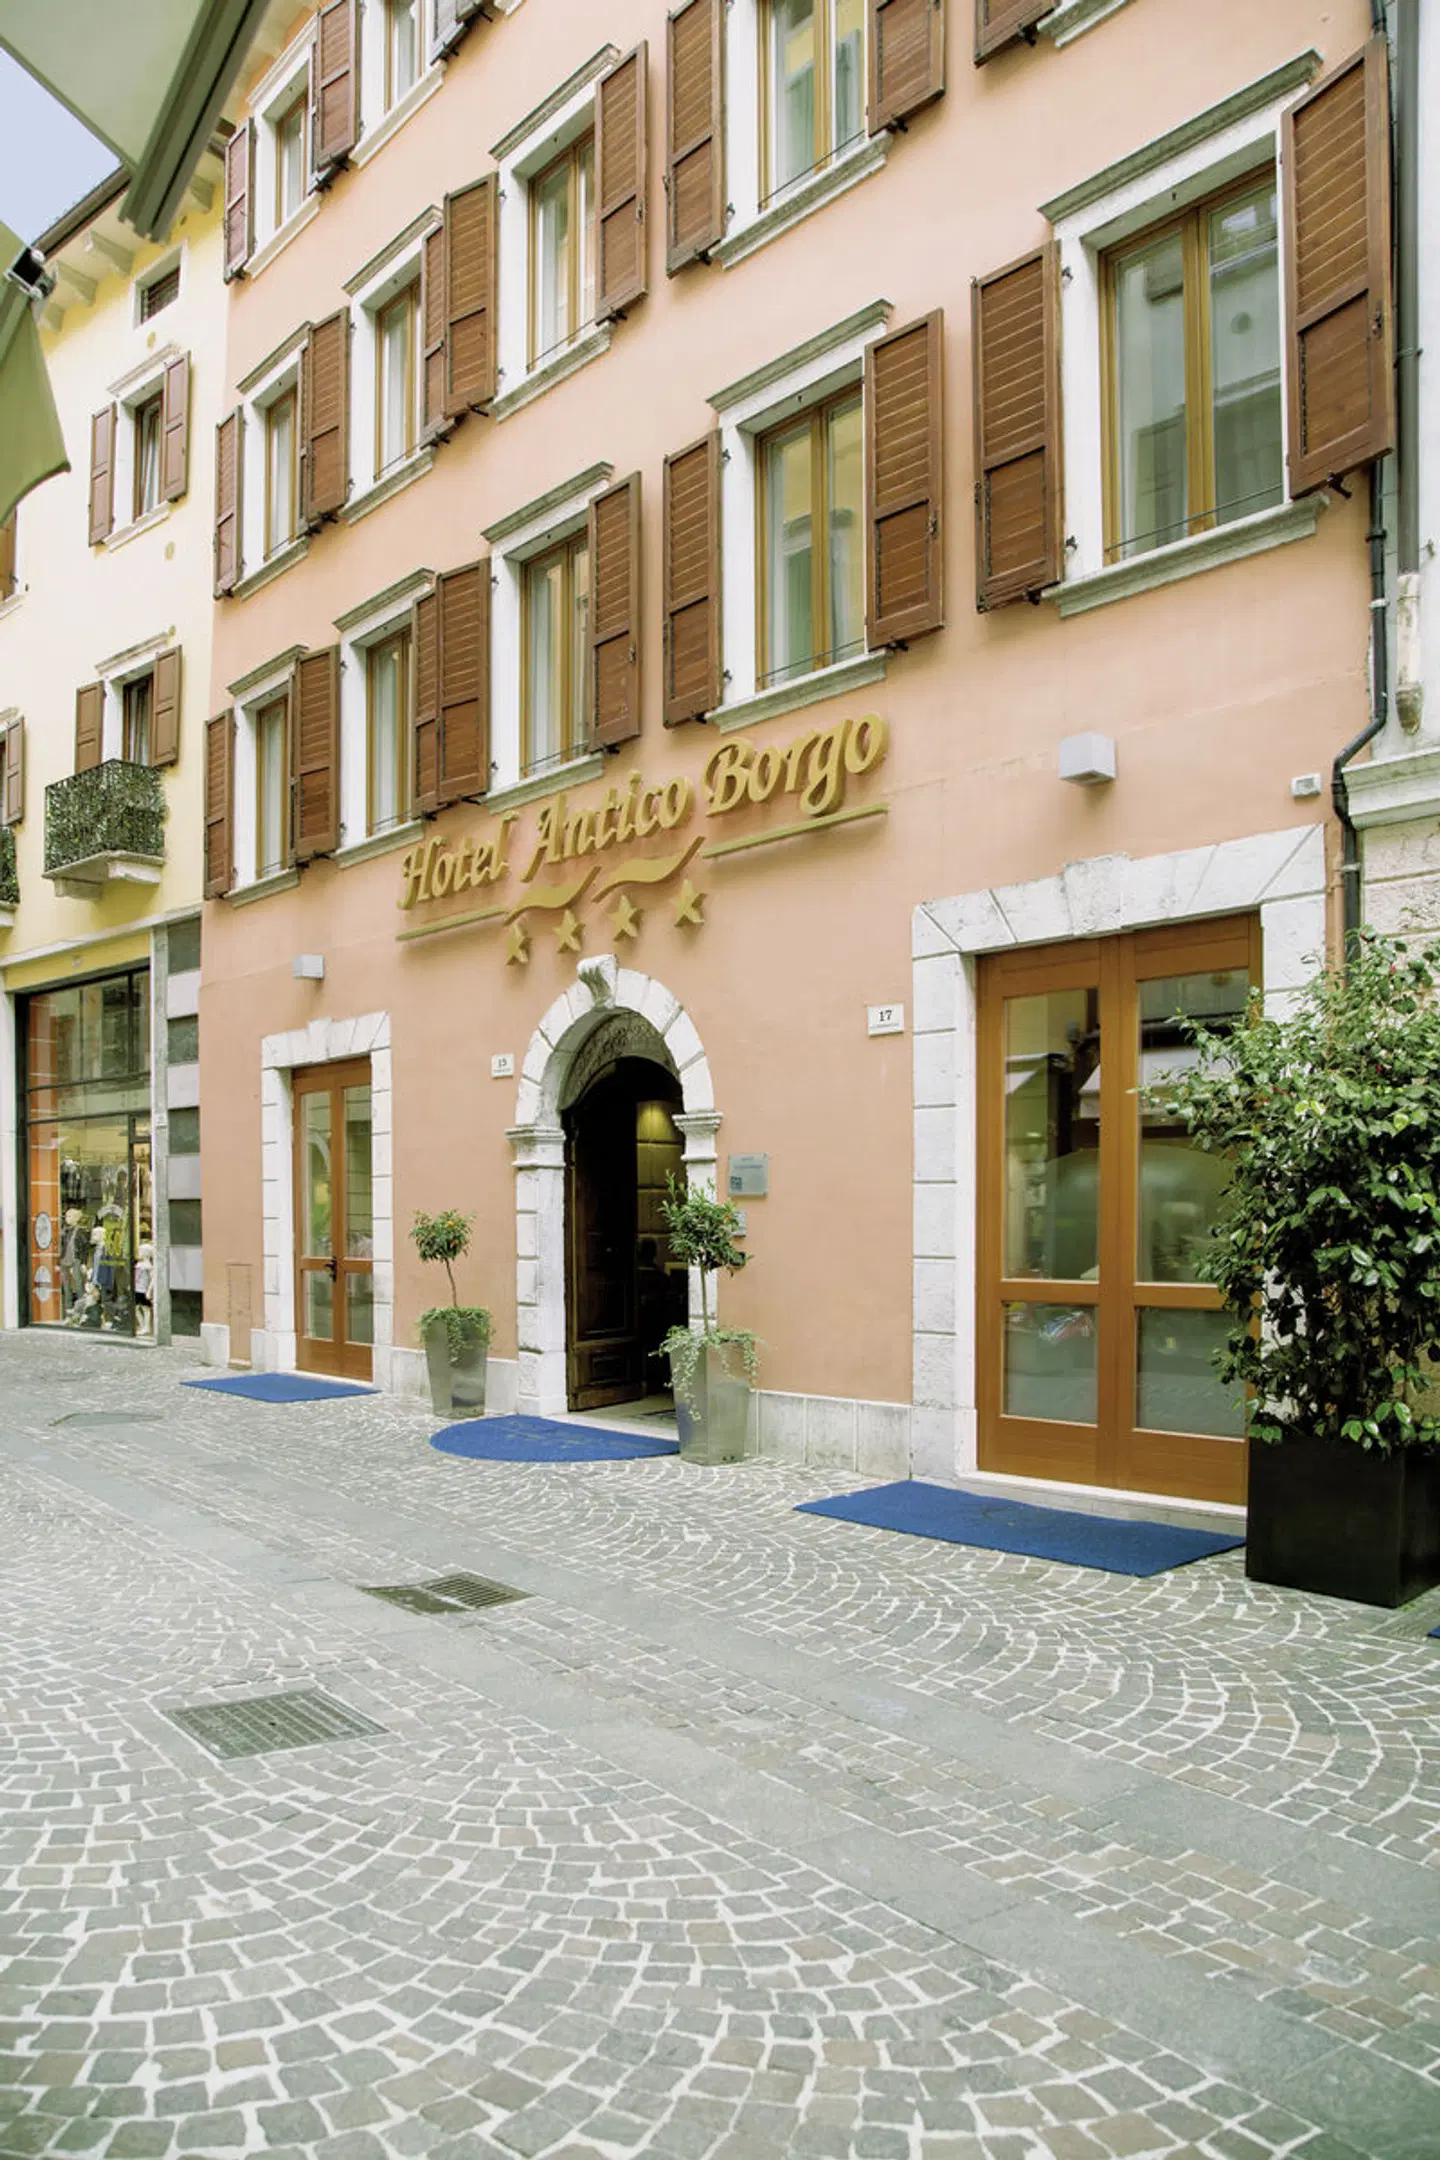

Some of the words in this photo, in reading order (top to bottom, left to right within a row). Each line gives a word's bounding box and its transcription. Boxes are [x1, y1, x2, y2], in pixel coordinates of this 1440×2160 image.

[397, 811, 519, 910] Hotel
[520, 769, 694, 883] Antico
[704, 712, 889, 816] Borgo
[879, 1009, 893, 1021] 17
